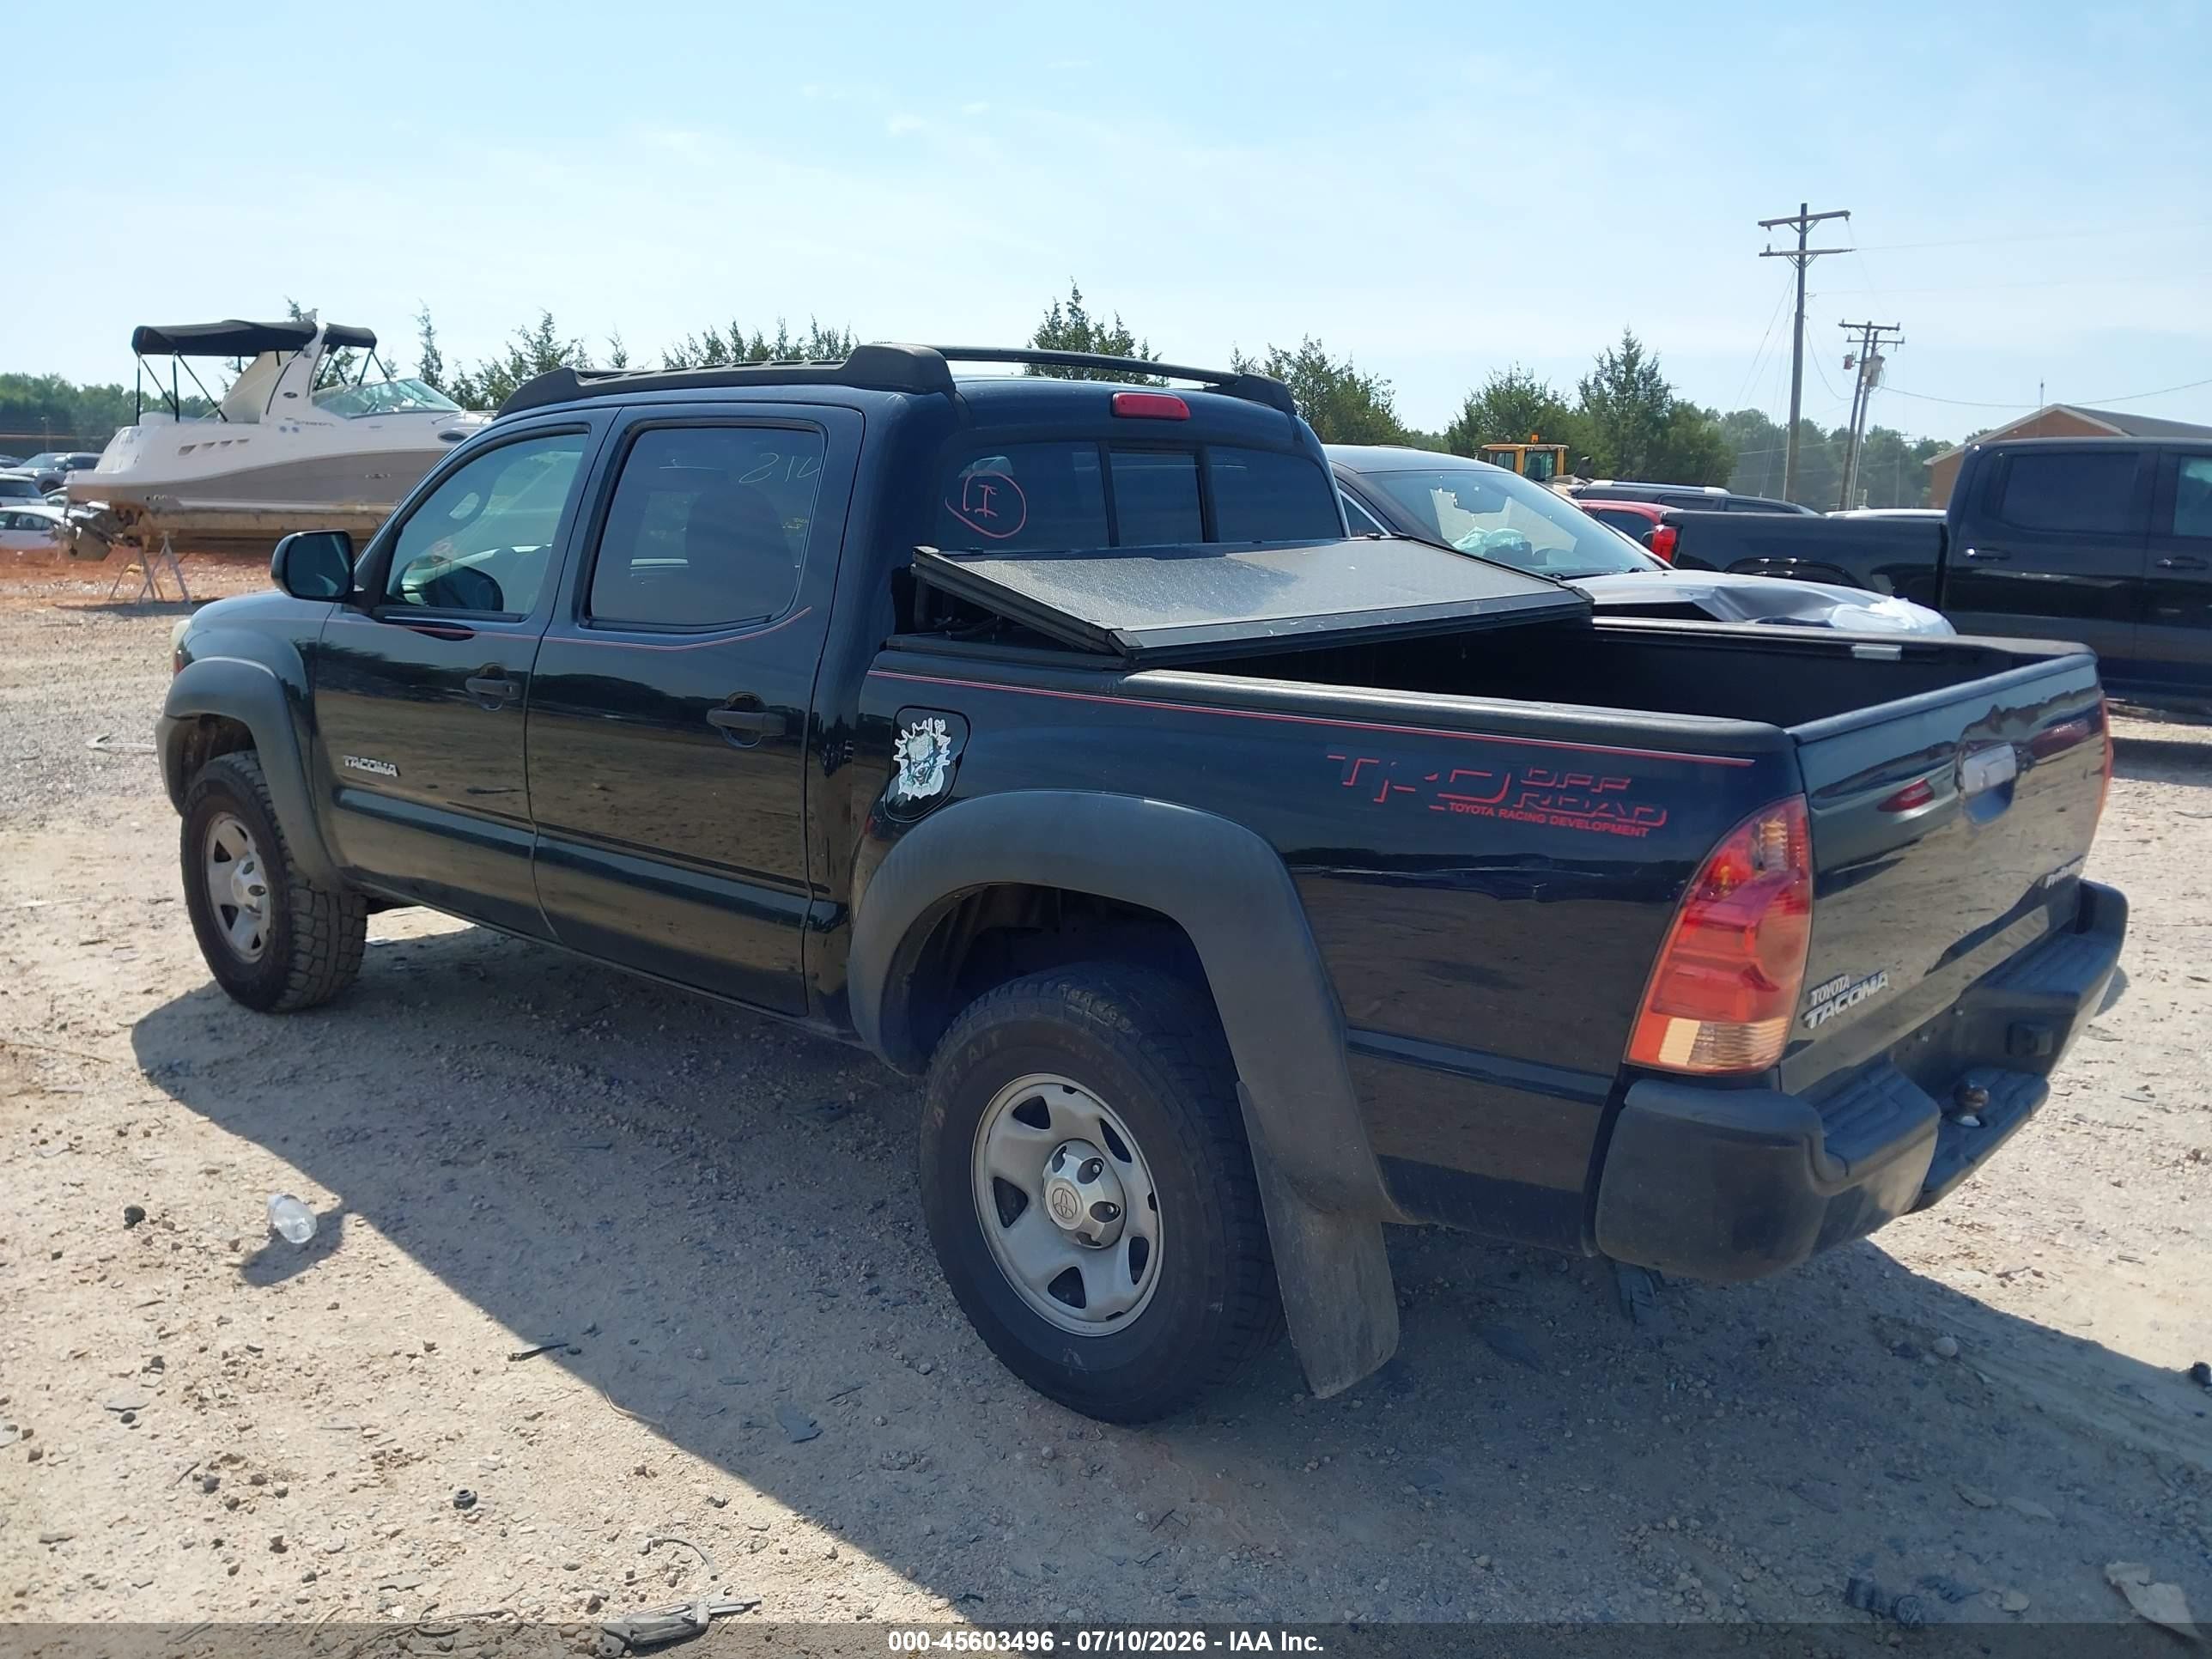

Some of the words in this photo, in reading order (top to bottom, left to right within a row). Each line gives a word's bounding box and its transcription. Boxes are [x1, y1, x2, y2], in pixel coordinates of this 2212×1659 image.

[343, 755, 398, 777] TACOMA
[1520, 767, 1632, 793] OFF
[1449, 802, 1495, 817] TOYOTA
[1498, 808, 1547, 824] RACING
[1549, 815, 1650, 838] DEVELOPMENT
[1512, 793, 1668, 827] ROAD
[1803, 971, 1889, 1030] TACOMA
[1808, 974, 1850, 1006] TOYOTA
